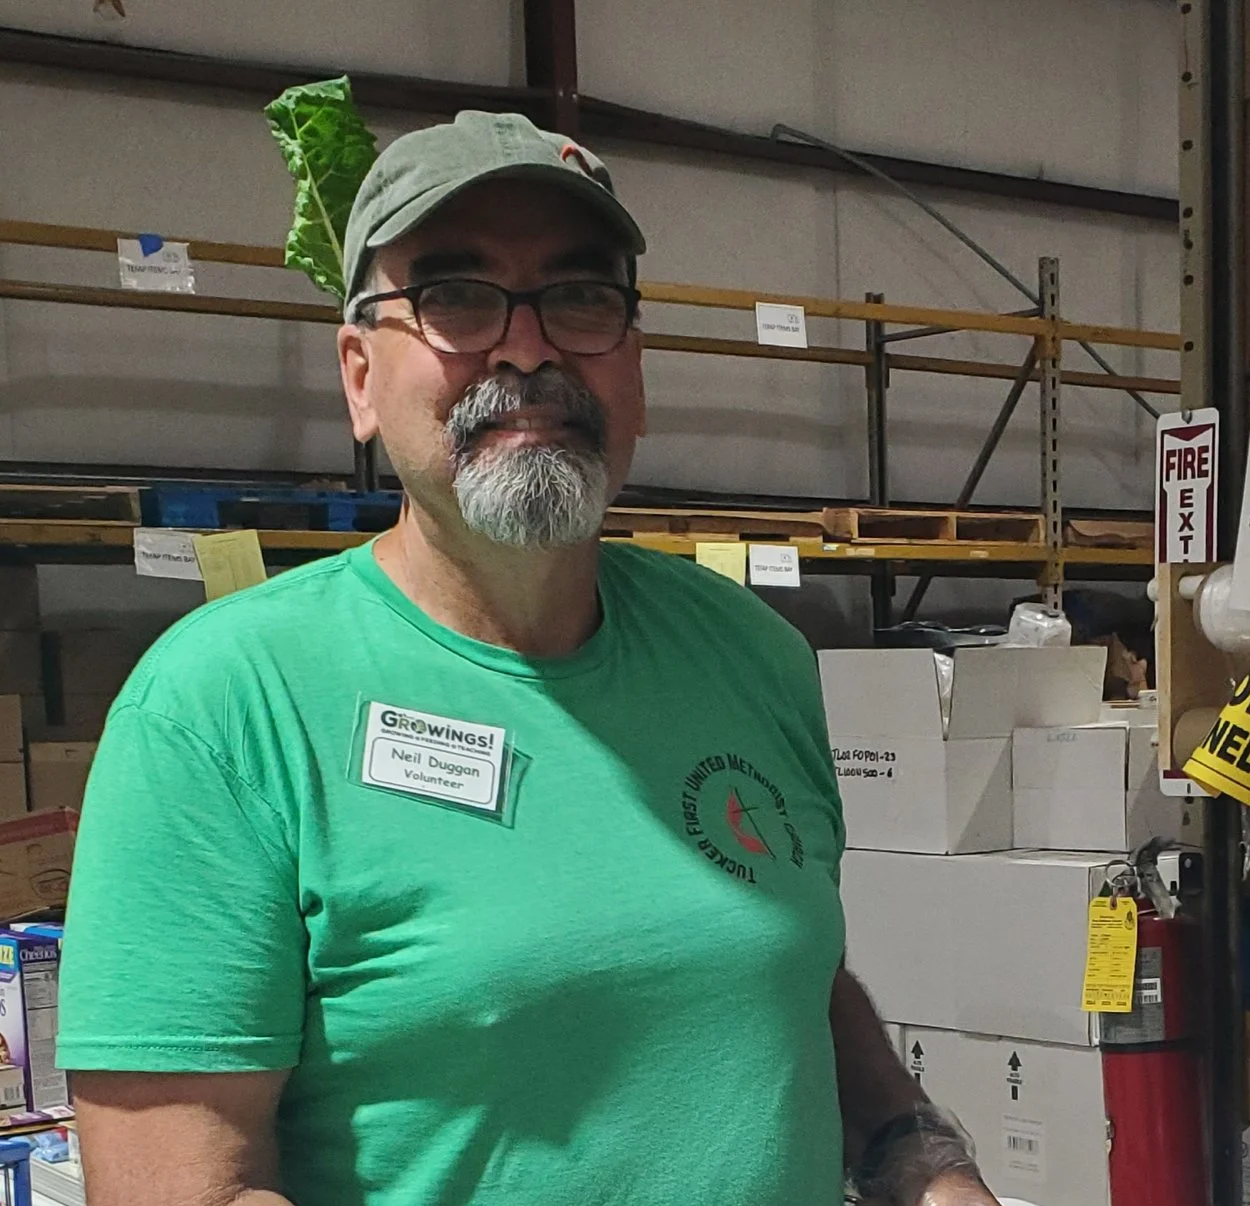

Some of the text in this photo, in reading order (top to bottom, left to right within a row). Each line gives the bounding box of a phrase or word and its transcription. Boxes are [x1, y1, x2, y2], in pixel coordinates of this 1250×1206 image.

[1165, 445, 1210, 482] FIRE
[391, 748, 480, 777] Neil Duggan
[404, 769, 465, 790] Volunteer
[684, 754, 727, 792] UNITED
[726, 753, 789, 818] METHODIST
[682, 791, 704, 836] FIRST
[697, 838, 757, 884] TUCKER
[19, 948, 57, 962] Cheerios
